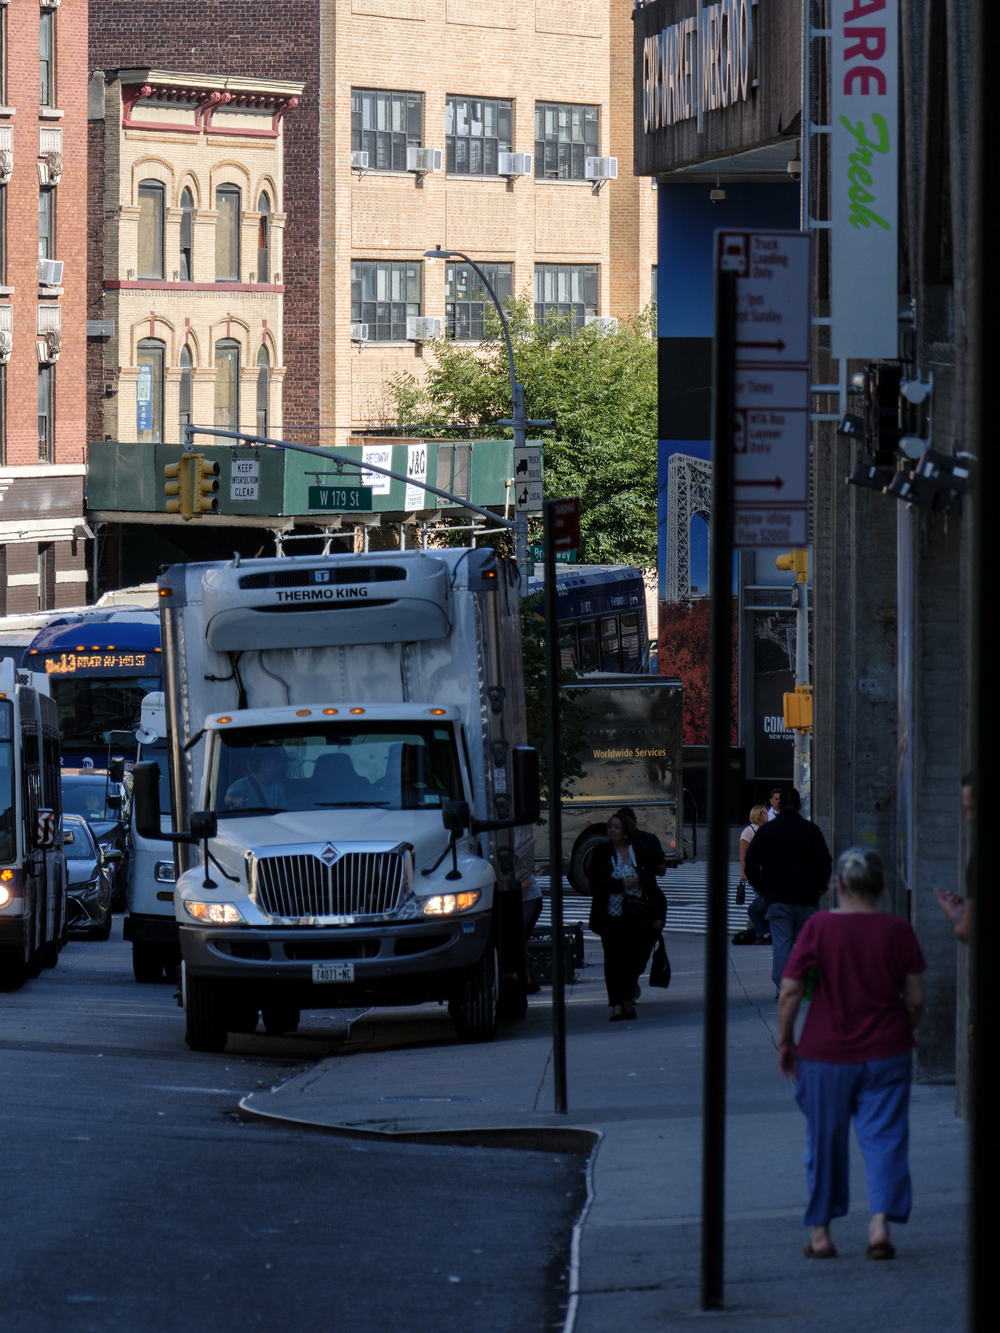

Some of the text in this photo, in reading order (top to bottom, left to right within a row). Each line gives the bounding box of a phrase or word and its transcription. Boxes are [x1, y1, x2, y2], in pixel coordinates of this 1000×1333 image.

[662, 16, 697, 127] MARKET
[837, 111, 892, 233] Fresh
[754, 238, 778, 250] Truck
[753, 255, 788, 267] Loading
[753, 267, 773, 281] Only
[751, 309, 782, 323] Sunday
[747, 380, 773, 393] Times
[750, 429, 782, 441] Layover
[750, 443, 771, 455] Only
[409, 449, 426, 475] J&G
[528, 456, 540, 464] TRUCK
[237, 463, 253, 473] KEEP
[231, 476, 258, 484] INTERSECTION
[235, 488, 255, 497] CLEAR
[320, 490, 360, 507] W 179 St
[529, 493, 541, 501] LOCAL
[534, 548, 571, 561] Brway
[276, 586, 368, 601] THERMO KING
[592, 747, 667, 759] Worldwide Services
